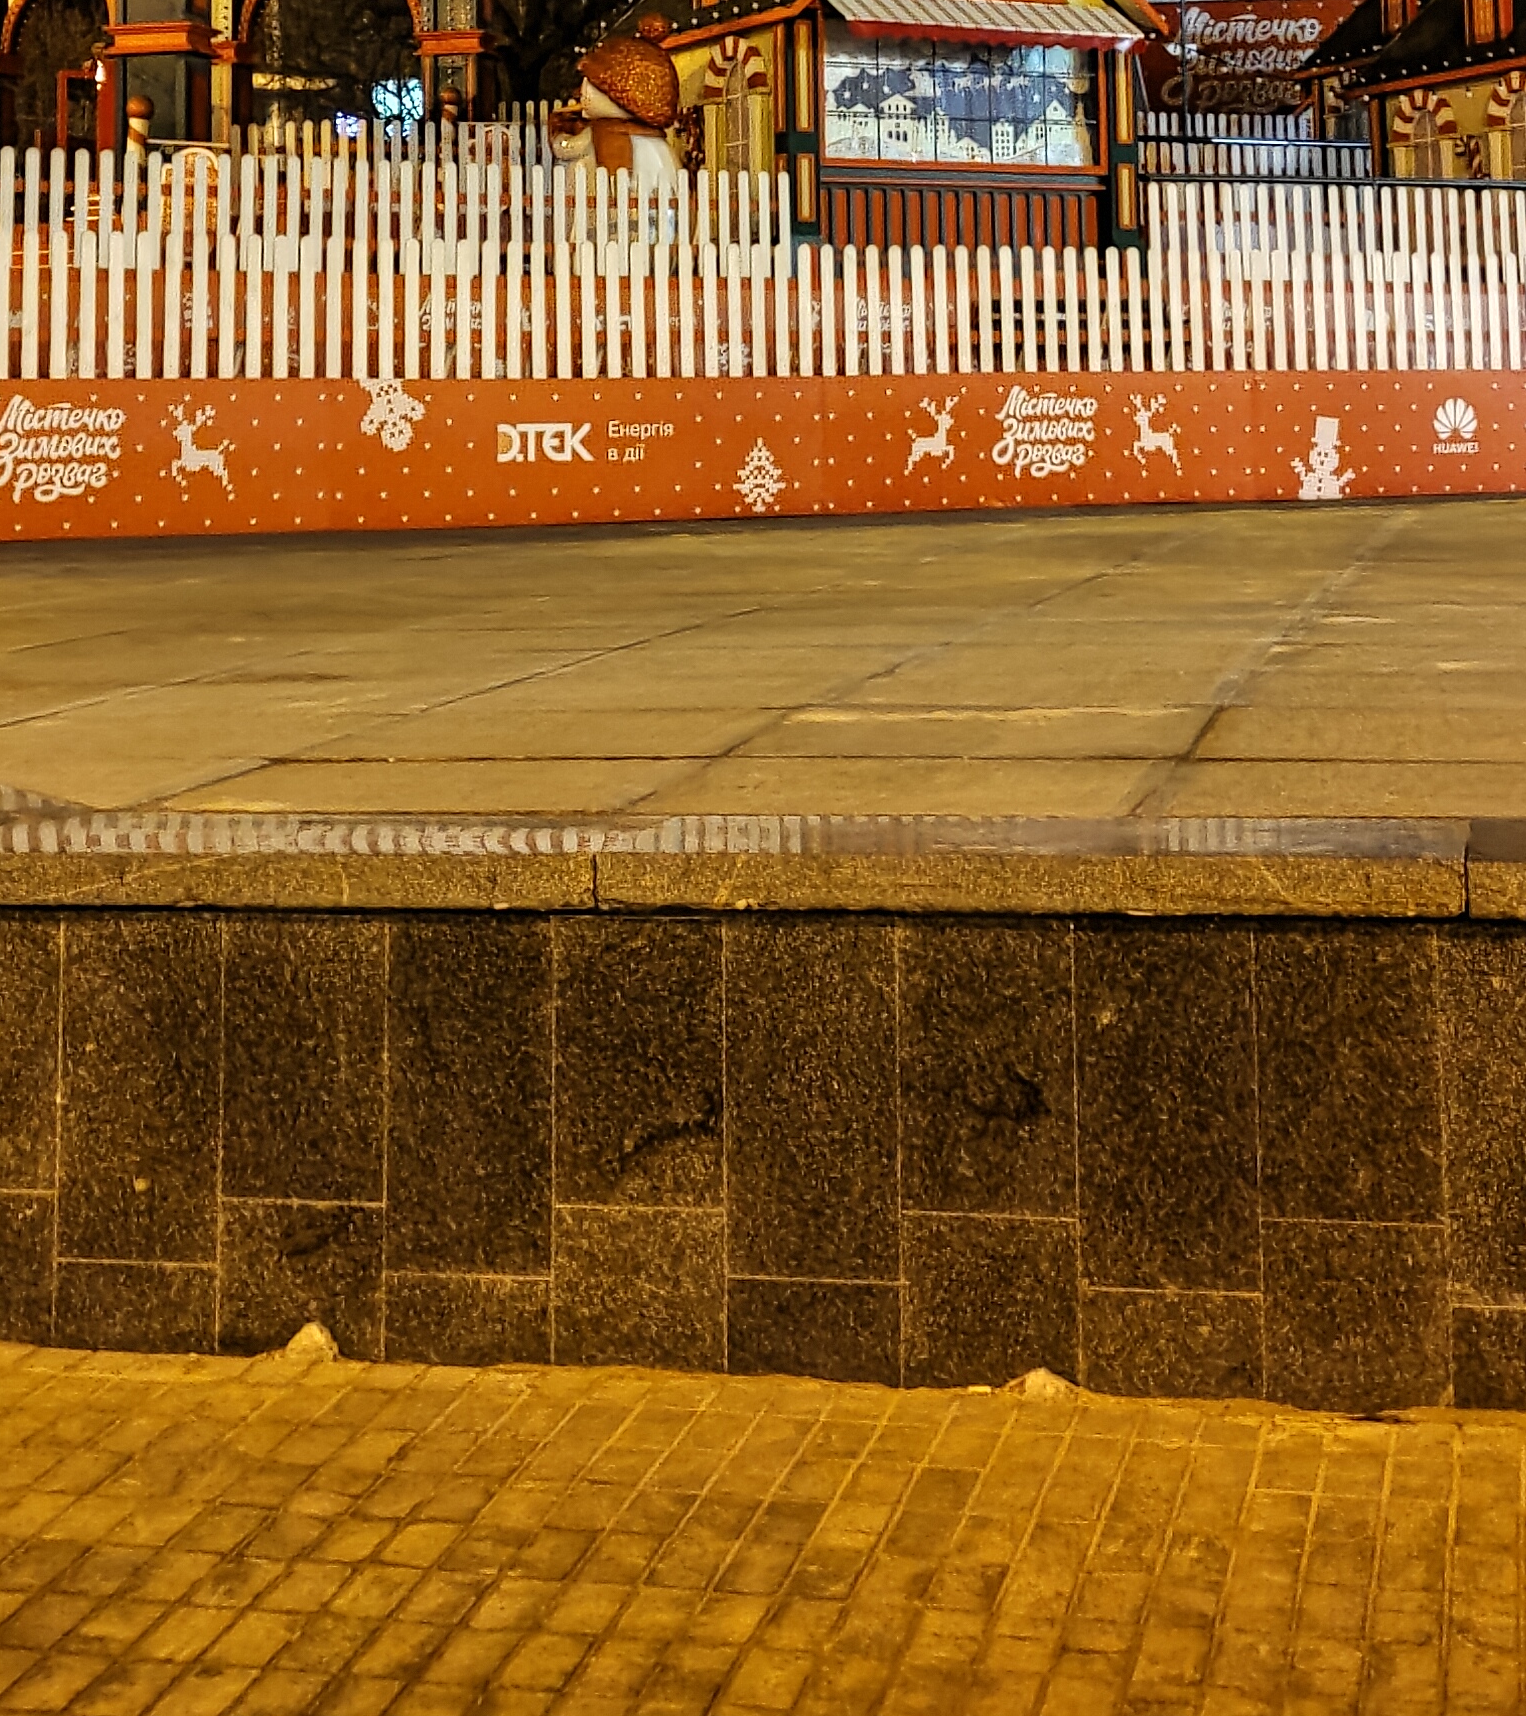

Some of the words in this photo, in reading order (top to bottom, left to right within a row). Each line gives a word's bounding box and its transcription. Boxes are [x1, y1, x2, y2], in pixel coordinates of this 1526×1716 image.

[995, 385, 1098, 420] Містечко
[608, 420, 674, 440] Енергія
[607, 448, 618, 461] в
[1433, 442, 1479, 454] HUAWEI
